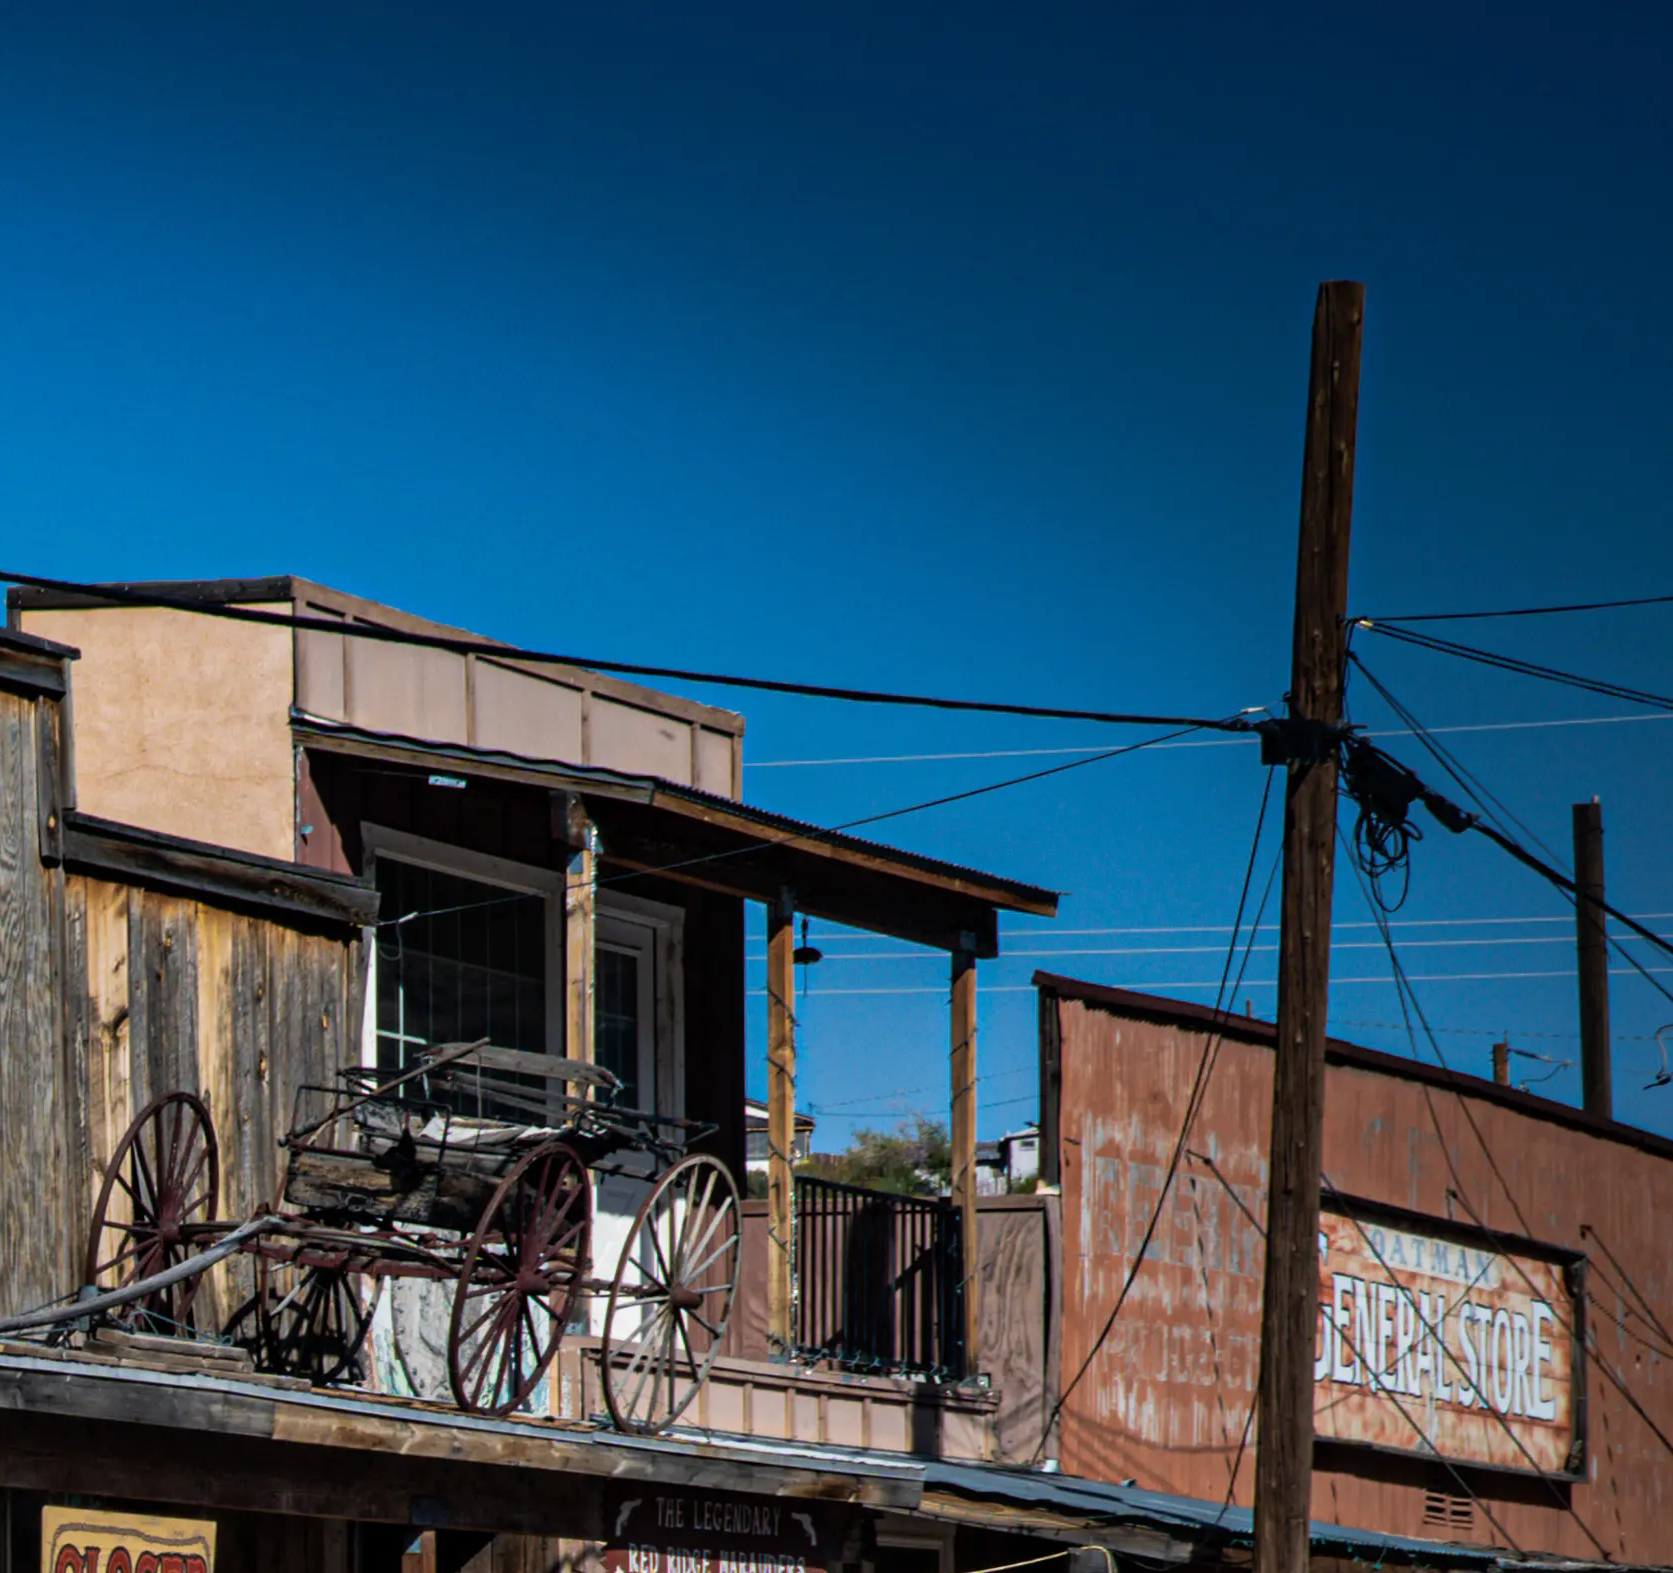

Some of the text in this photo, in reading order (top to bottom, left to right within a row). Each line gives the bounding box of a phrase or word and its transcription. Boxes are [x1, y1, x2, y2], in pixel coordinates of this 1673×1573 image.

[1371, 1229, 1492, 1283] OATMAN
[1457, 1299, 1556, 1422] STORE
[655, 1496, 782, 1538] THE LEGENDARY
